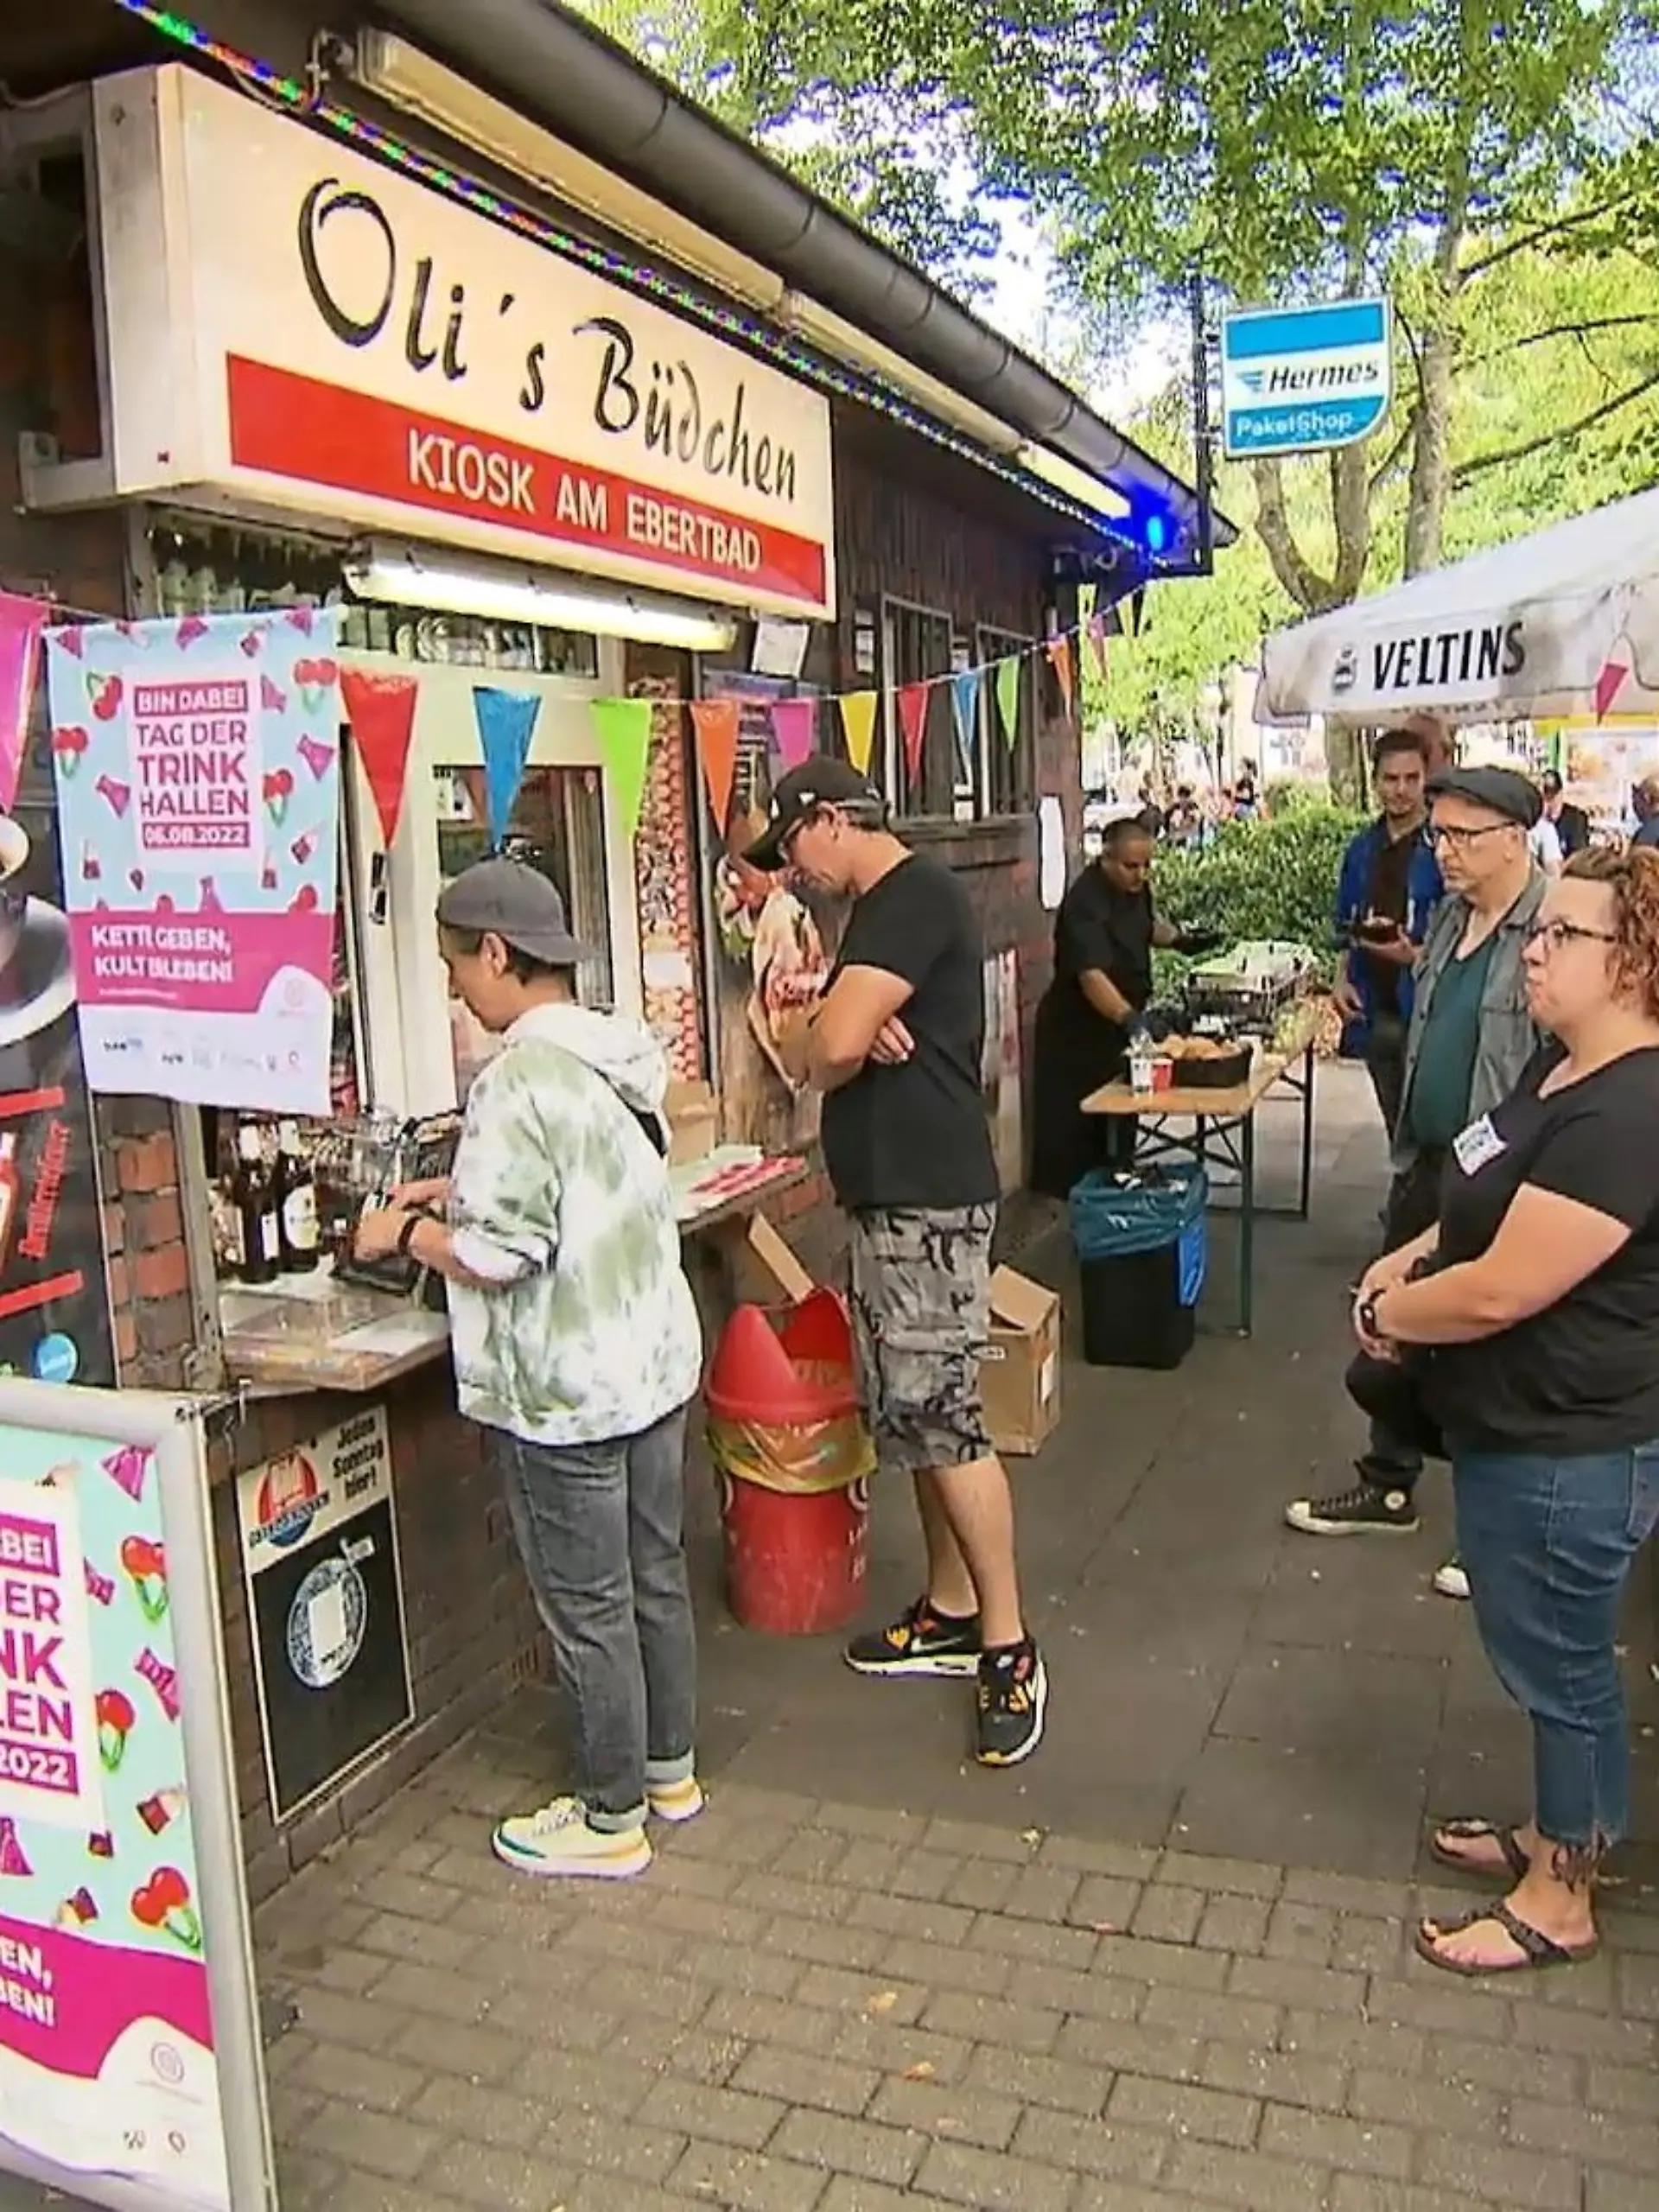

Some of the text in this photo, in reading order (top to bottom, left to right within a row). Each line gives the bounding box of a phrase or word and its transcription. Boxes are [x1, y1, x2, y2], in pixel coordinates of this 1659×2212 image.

[1269, 359, 1379, 393] Hermes
[573, 315, 797, 500] Büdchen
[408, 426, 760, 572] KIOSK AM EBERTBAD
[1373, 621, 1526, 690] VELTINS
[137, 687, 245, 713] BIN DABEI
[137, 719, 247, 747] TAG DER
[137, 750, 247, 786] TRINK
[139, 789, 249, 817] HALLEN
[94, 955, 147, 977] KULT
[0, 1688, 73, 1743] EN
